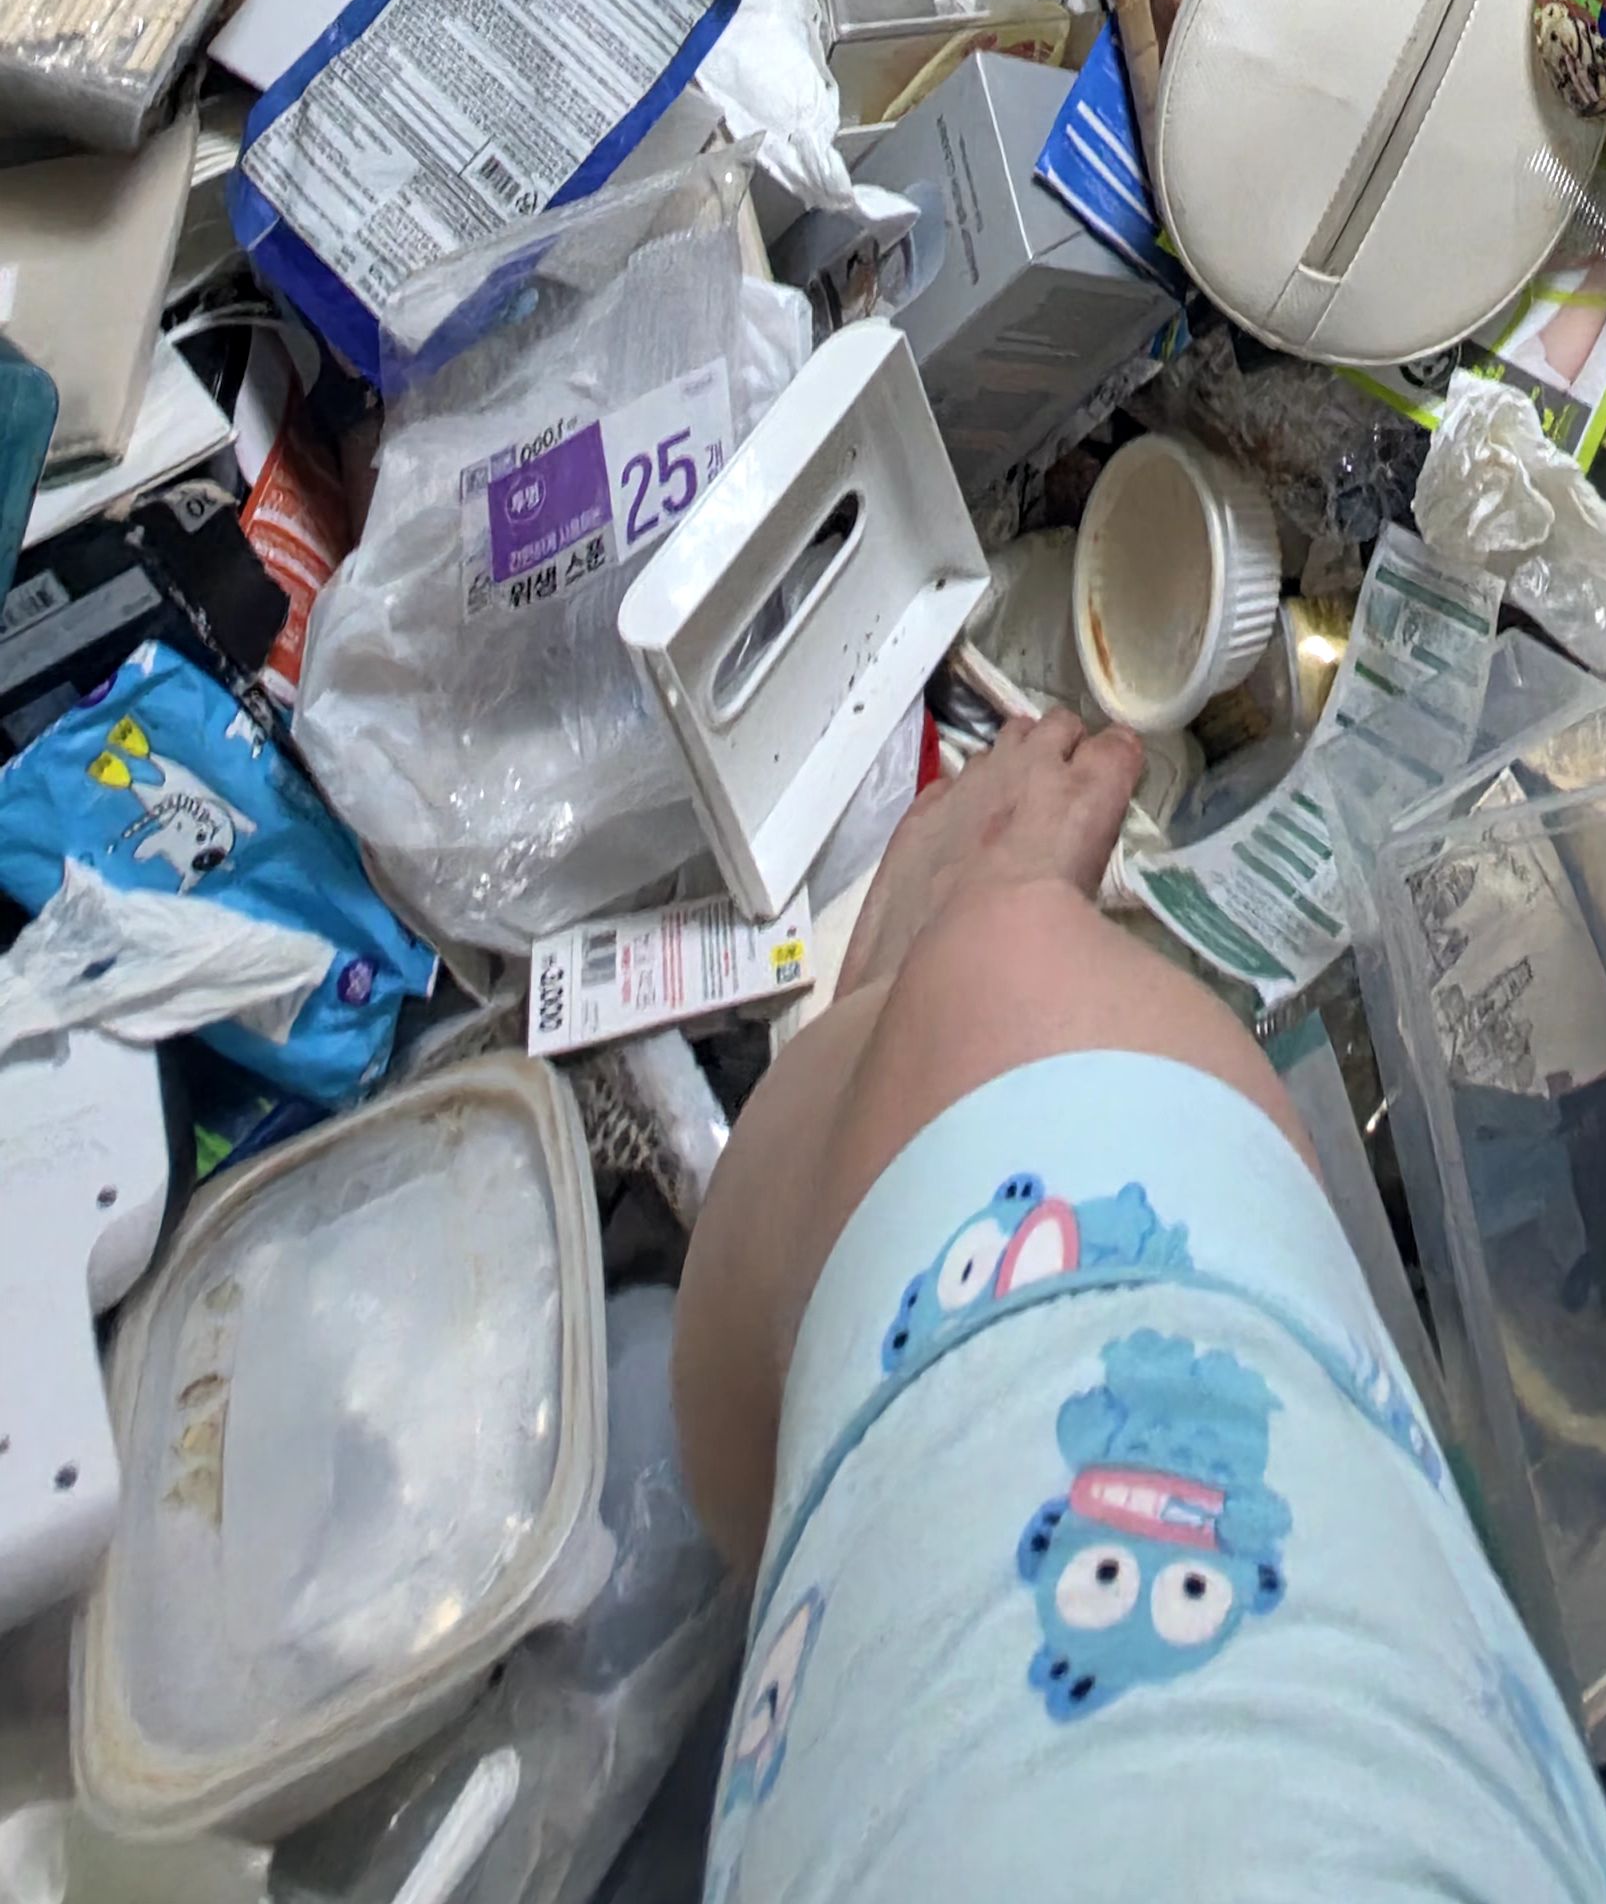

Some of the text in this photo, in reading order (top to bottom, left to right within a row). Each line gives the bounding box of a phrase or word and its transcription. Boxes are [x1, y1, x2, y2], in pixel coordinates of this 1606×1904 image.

[621, 428, 698, 545] 25
[509, 535, 607, 608] 위생 스푼
